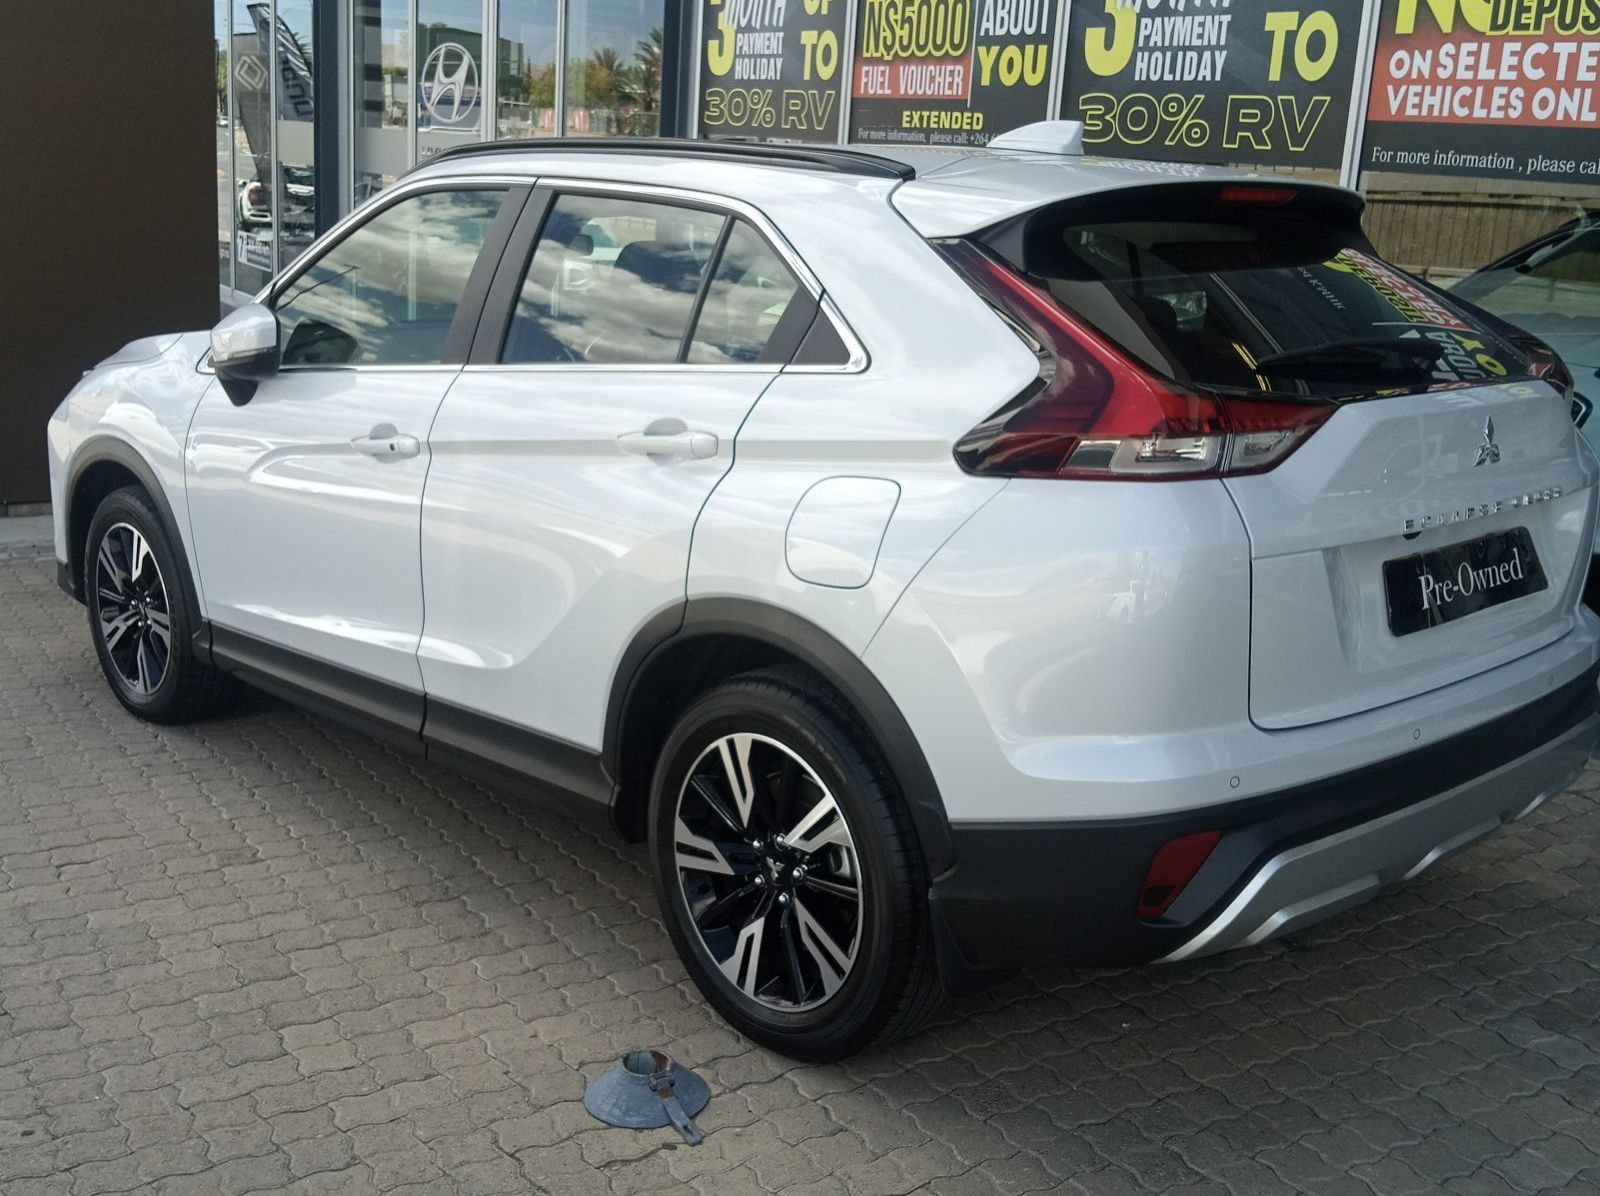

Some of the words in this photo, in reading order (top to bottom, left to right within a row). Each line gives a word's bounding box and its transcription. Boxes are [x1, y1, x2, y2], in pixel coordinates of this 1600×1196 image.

[979, 0, 1048, 36] ABOUT
[1138, 14, 1231, 47] PAYMENT
[736, 32, 785, 55] PAYMENT
[800, 30, 838, 81] TO
[1264, 10, 1339, 82] TO
[734, 57, 783, 80] HOLIDAY
[860, 65, 892, 95] FUEL
[899, 65, 964, 96] VOUCHER
[977, 44, 1048, 87] YOU
[1134, 51, 1227, 82] HOLIDAY
[1389, 49, 1432, 79] ON
[704, 87, 776, 128] 30%
[781, 89, 836, 130] RV
[1387, 84, 1525, 119] VEHICLES
[858, 128, 870, 140] For
[870, 130, 886, 141] more
[929, 131, 953, 145] please
[901, 110, 984, 130] EXTENDED
[1079, 93, 1209, 147] 30%
[1222, 95, 1331, 151] RV
[1372, 146, 1394, 163] For
[1396, 151, 1430, 165] more
[1526, 154, 1576, 175] please
[1418, 547, 1524, 610] Pre-Owned
